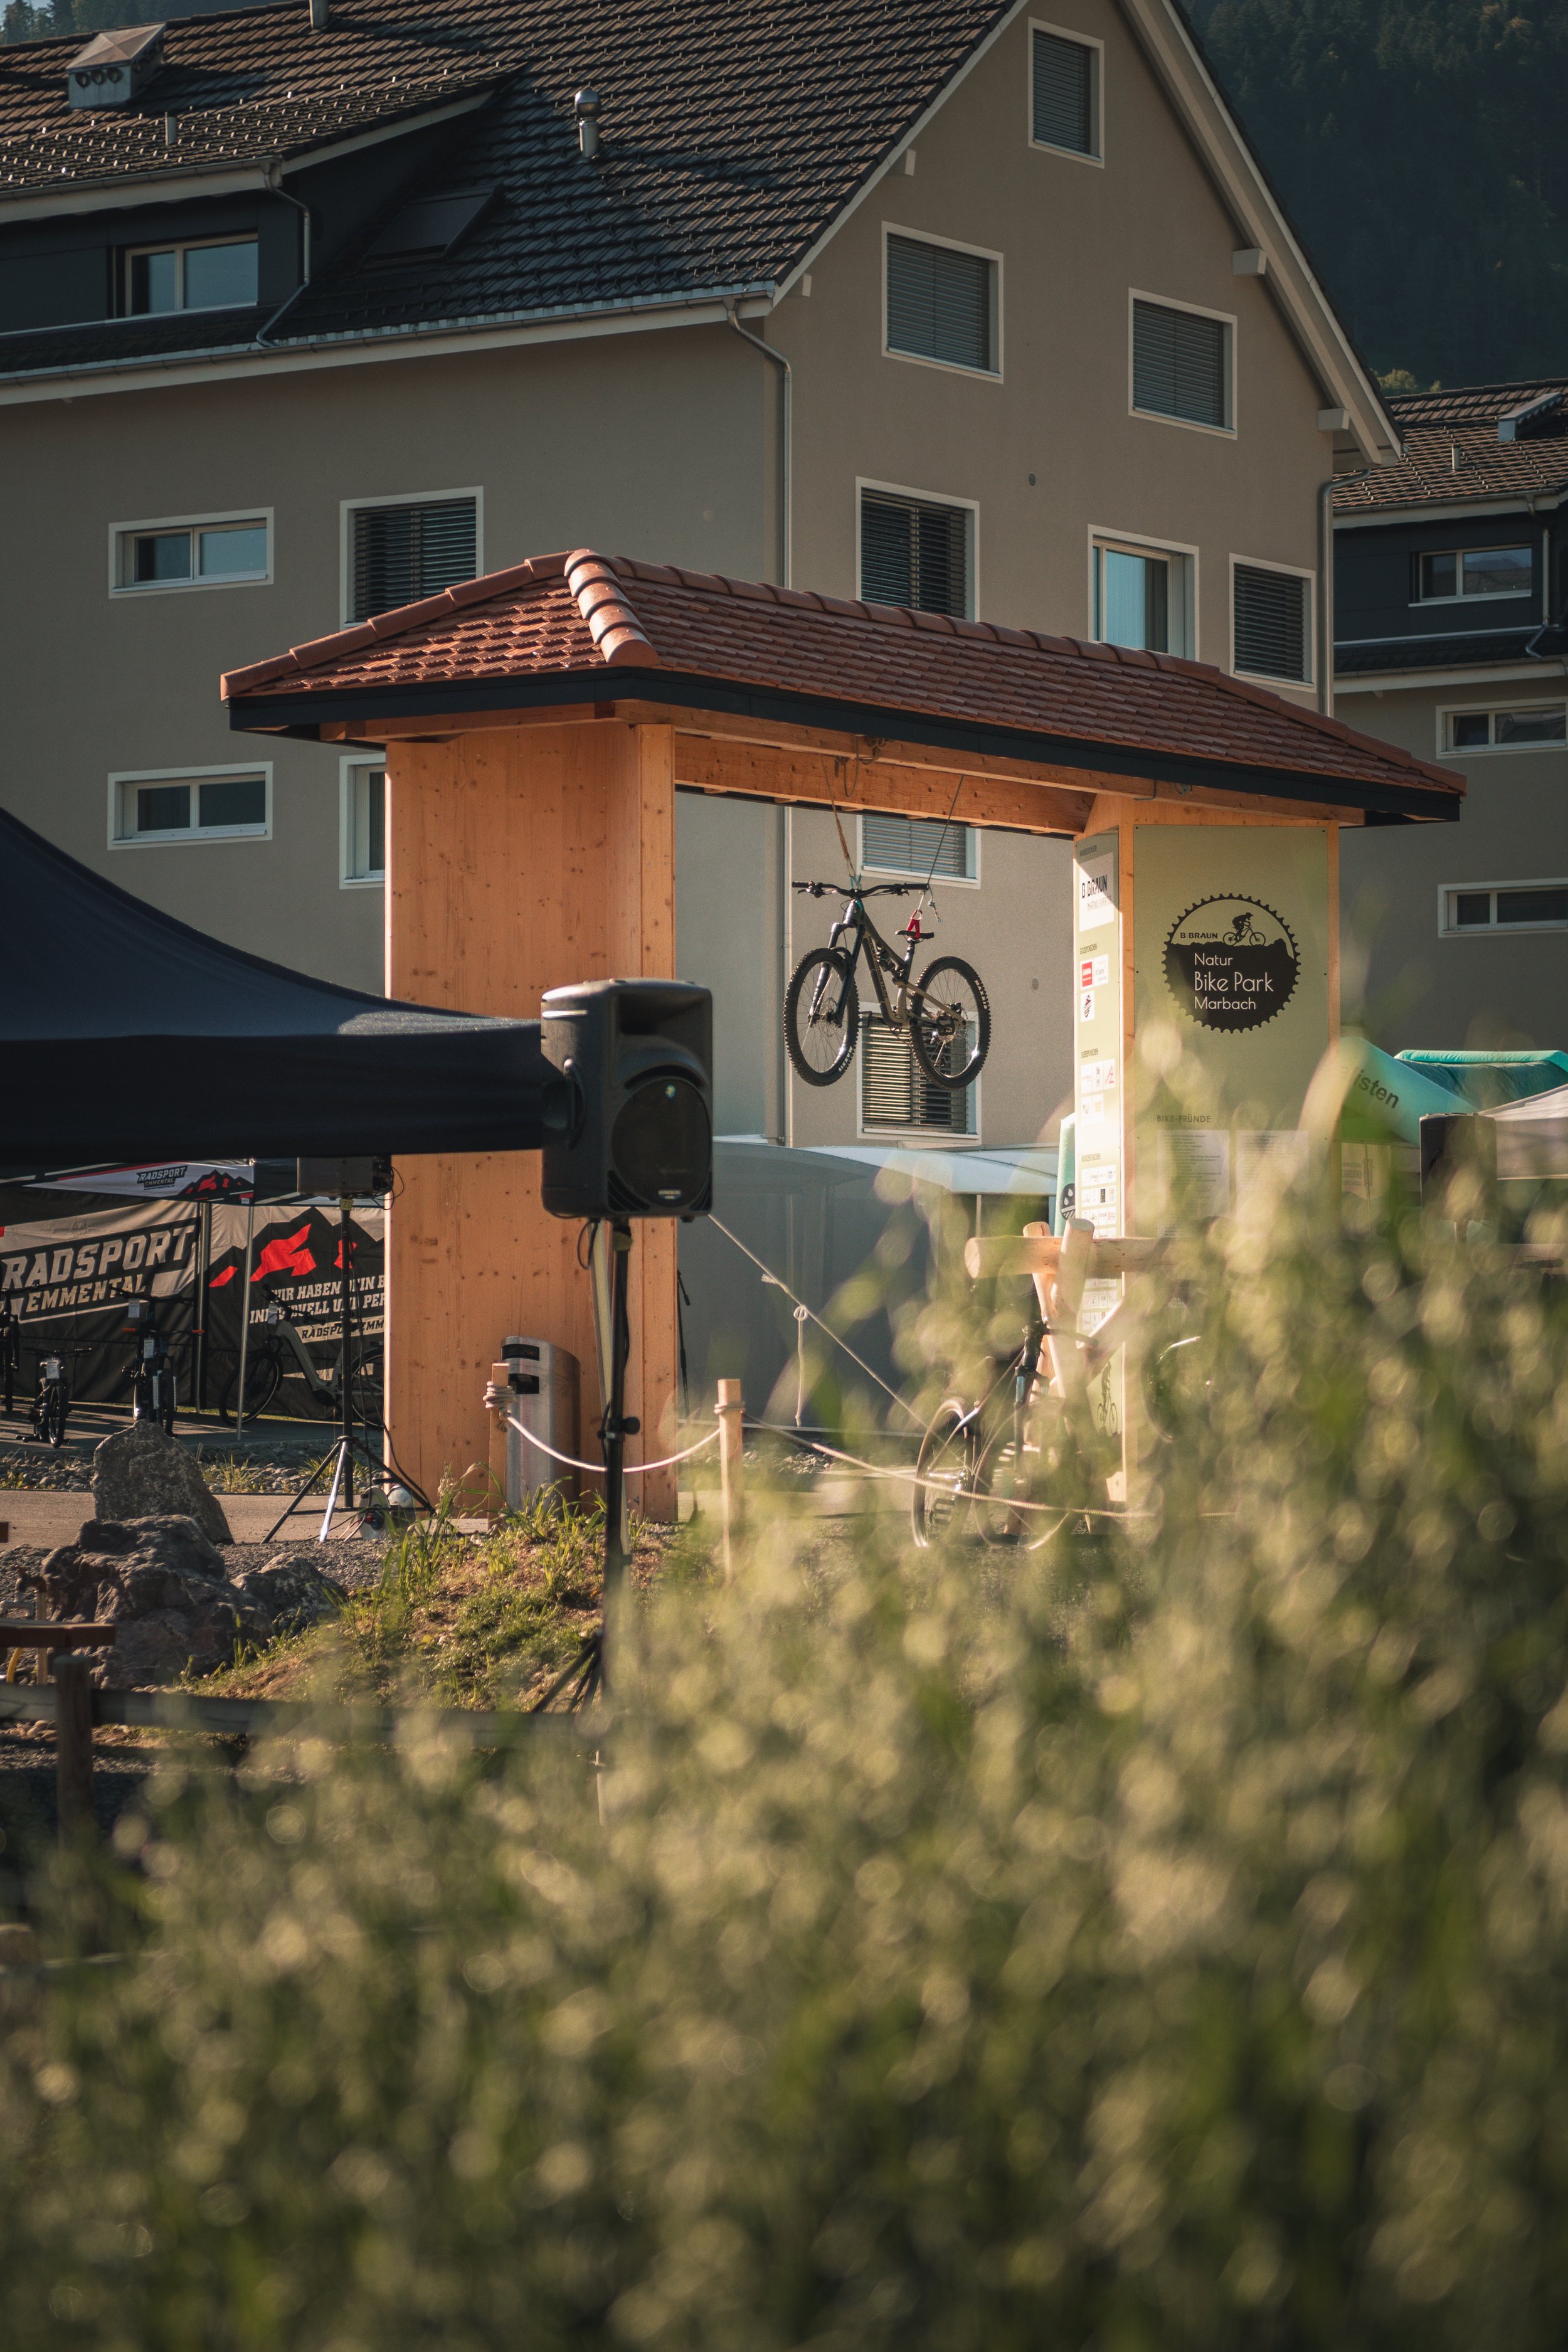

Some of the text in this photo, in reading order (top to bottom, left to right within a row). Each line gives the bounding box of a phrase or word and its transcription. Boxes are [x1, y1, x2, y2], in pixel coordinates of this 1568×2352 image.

[1081, 874, 1108, 899] B BRAUN
[1194, 953, 1233, 966] Natur
[1194, 971, 1274, 992] Bike Park
[974, 980, 988, 1009] MAXXIS
[1194, 996, 1256, 1010] Marbach
[1348, 1066, 1399, 1109] isten
[1157, 1113, 1210, 1123] BIKE-FRÜNDE
[139, 1166, 186, 1182] RADSPORT
[144, 1177, 174, 1187] EMMENTAL
[1, 1225, 195, 1290] RADSPORT
[26, 1273, 147, 1313] EMMENTAL
[297, 1281, 342, 1300] HABEN
